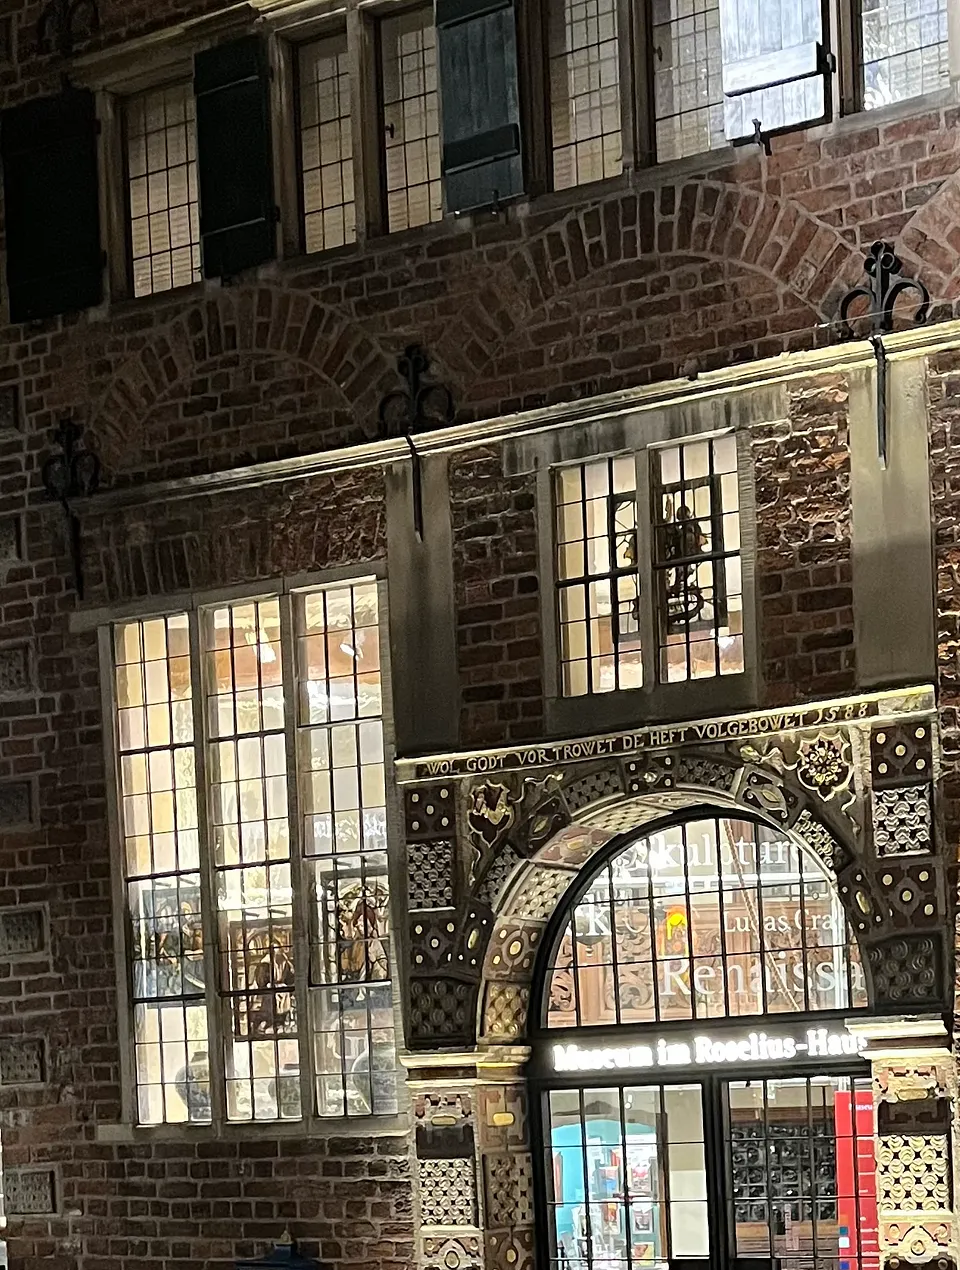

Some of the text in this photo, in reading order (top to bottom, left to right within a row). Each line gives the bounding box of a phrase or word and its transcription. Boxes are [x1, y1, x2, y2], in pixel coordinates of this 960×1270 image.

[426, 759, 460, 775] WOL
[466, 754, 508, 772] GODT
[622, 734, 645, 750] DE
[650, 726, 690, 746] HEFT
[693, 710, 810, 739] VOLGEBOWET
[657, 1038, 692, 1065] im
